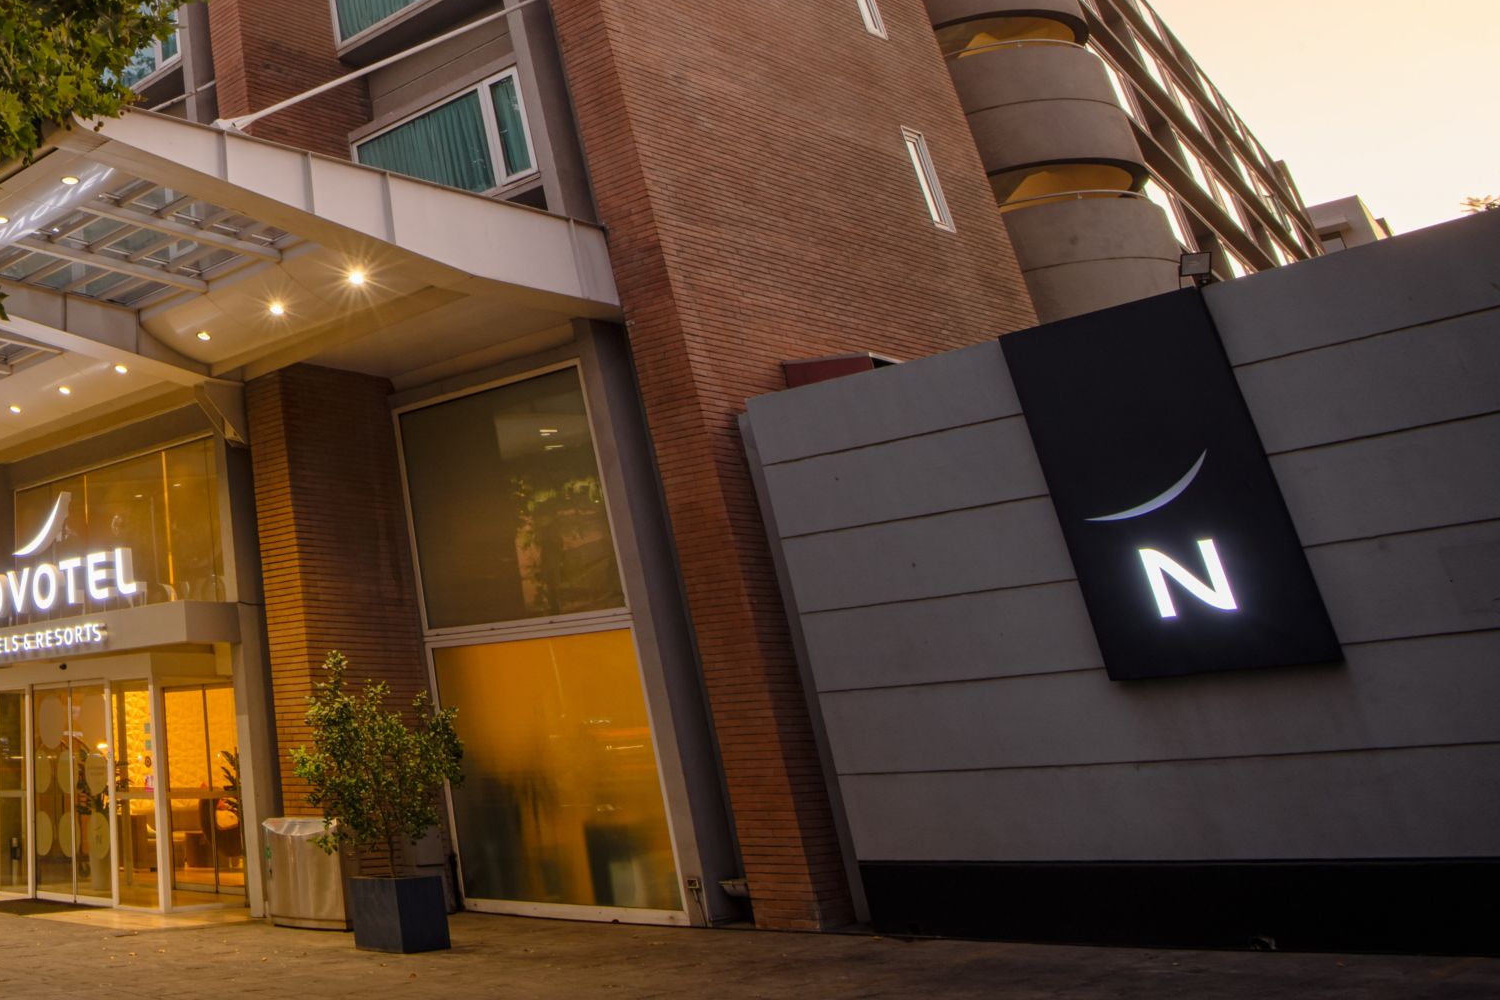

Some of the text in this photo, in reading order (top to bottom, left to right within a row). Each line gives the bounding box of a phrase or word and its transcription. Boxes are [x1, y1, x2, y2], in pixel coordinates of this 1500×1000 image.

[1138, 538, 1238, 619] N
[23, 633, 32, 651] &
[35, 623, 103, 649] RESORTS
